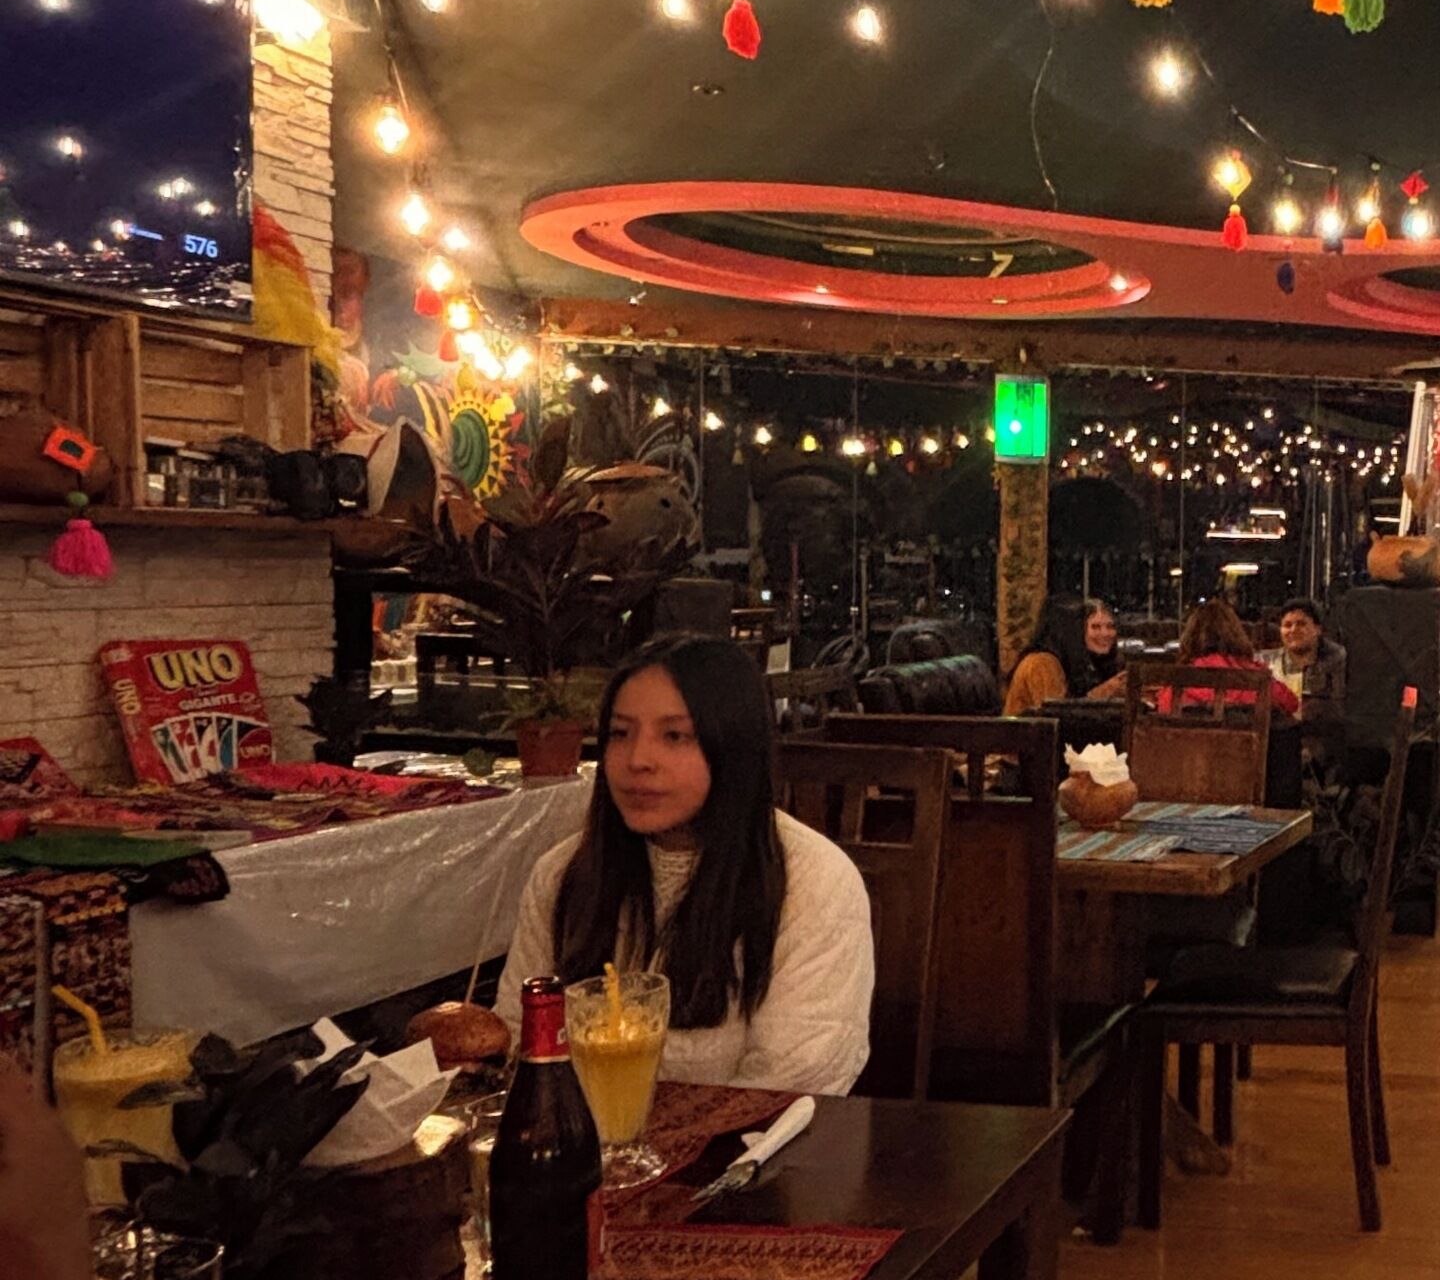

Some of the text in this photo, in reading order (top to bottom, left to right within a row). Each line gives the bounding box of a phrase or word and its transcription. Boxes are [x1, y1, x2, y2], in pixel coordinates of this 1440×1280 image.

[184, 234, 218, 258] 576
[147, 644, 243, 693] UNO
[112, 678, 141, 715] UNO
[178, 693, 236, 711] GIGANTE
